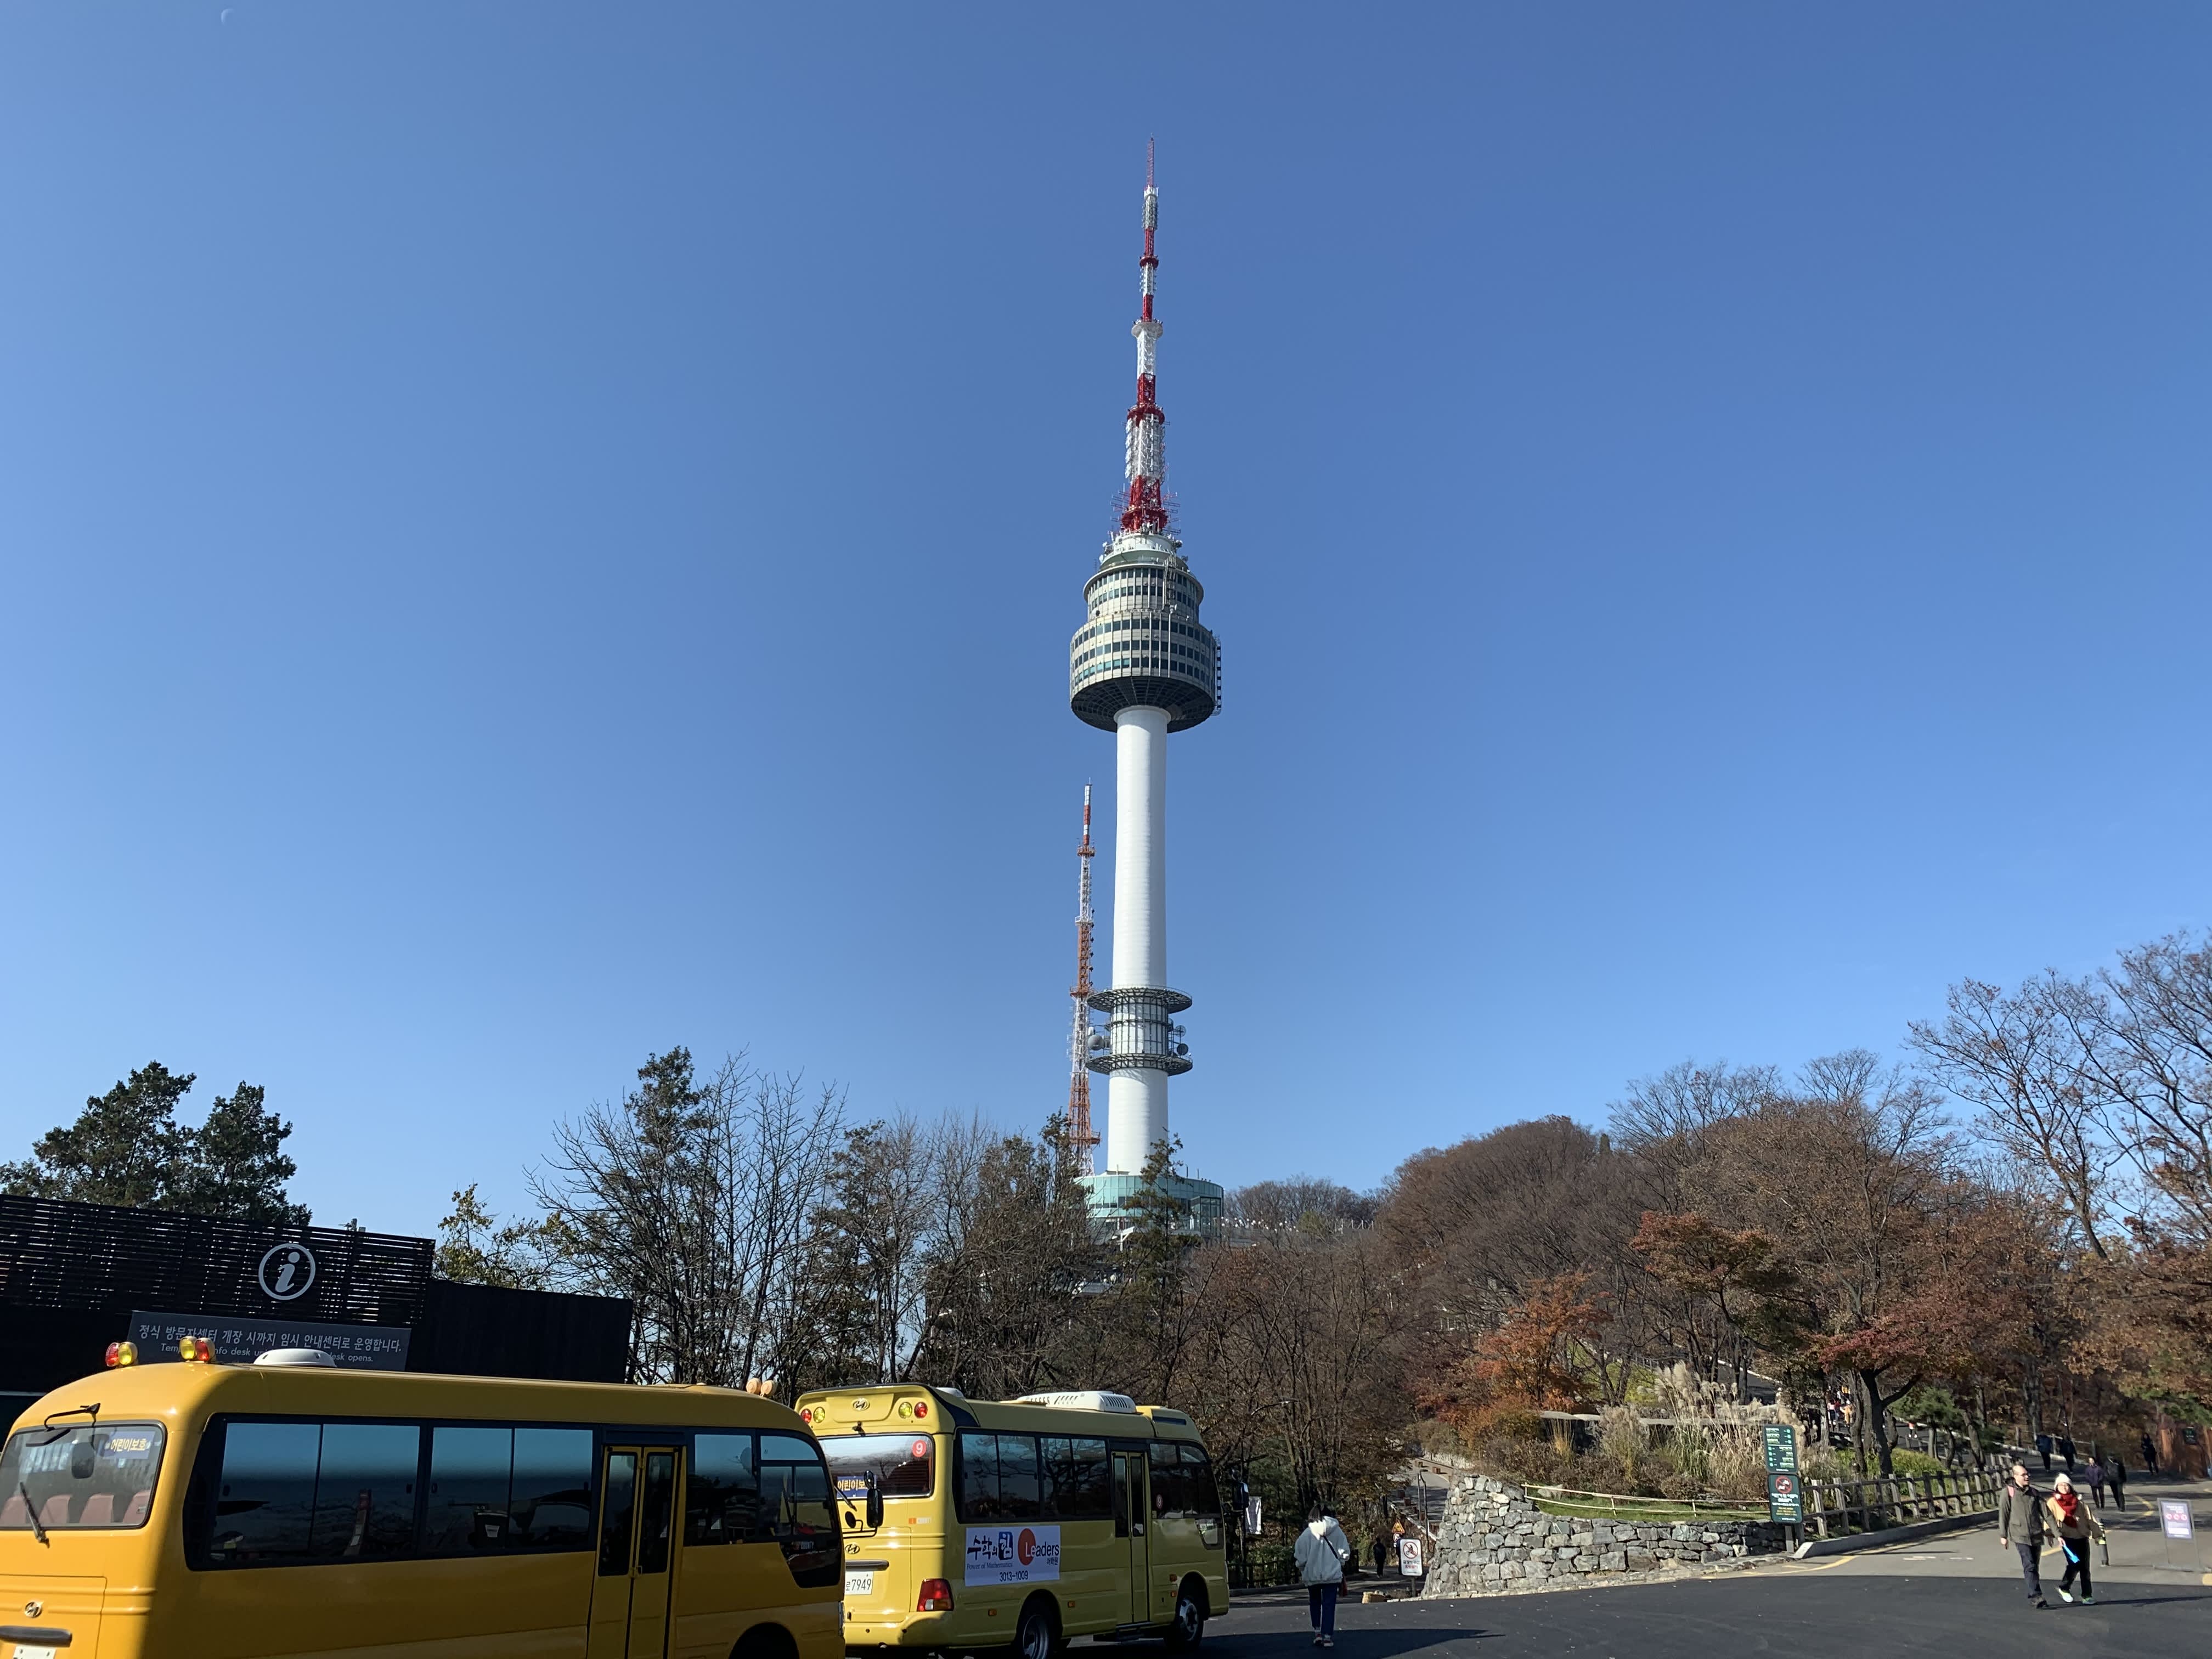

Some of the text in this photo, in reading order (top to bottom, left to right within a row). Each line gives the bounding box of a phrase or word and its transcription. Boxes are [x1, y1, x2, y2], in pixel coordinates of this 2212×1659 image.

[139, 1324, 160, 1339] 정식
[222, 1330, 242, 1344] 개장
[246, 1331, 276, 1346] 시까지
[281, 1333, 300, 1347] 임시
[304, 1335, 351, 1349] 안내센터로
[354, 1338, 402, 1352] 운영합니다.
[215, 1346, 228, 1355] nfo
[231, 1347, 251, 1356] desk
[110, 1438, 146, 1452] 어린이보호
[916, 1442, 923, 1454] 9
[837, 1479, 868, 1491] 어린이보
[1025, 1541, 1059, 1557] Leaders
[1000, 1571, 1028, 1582] 3013-1009
